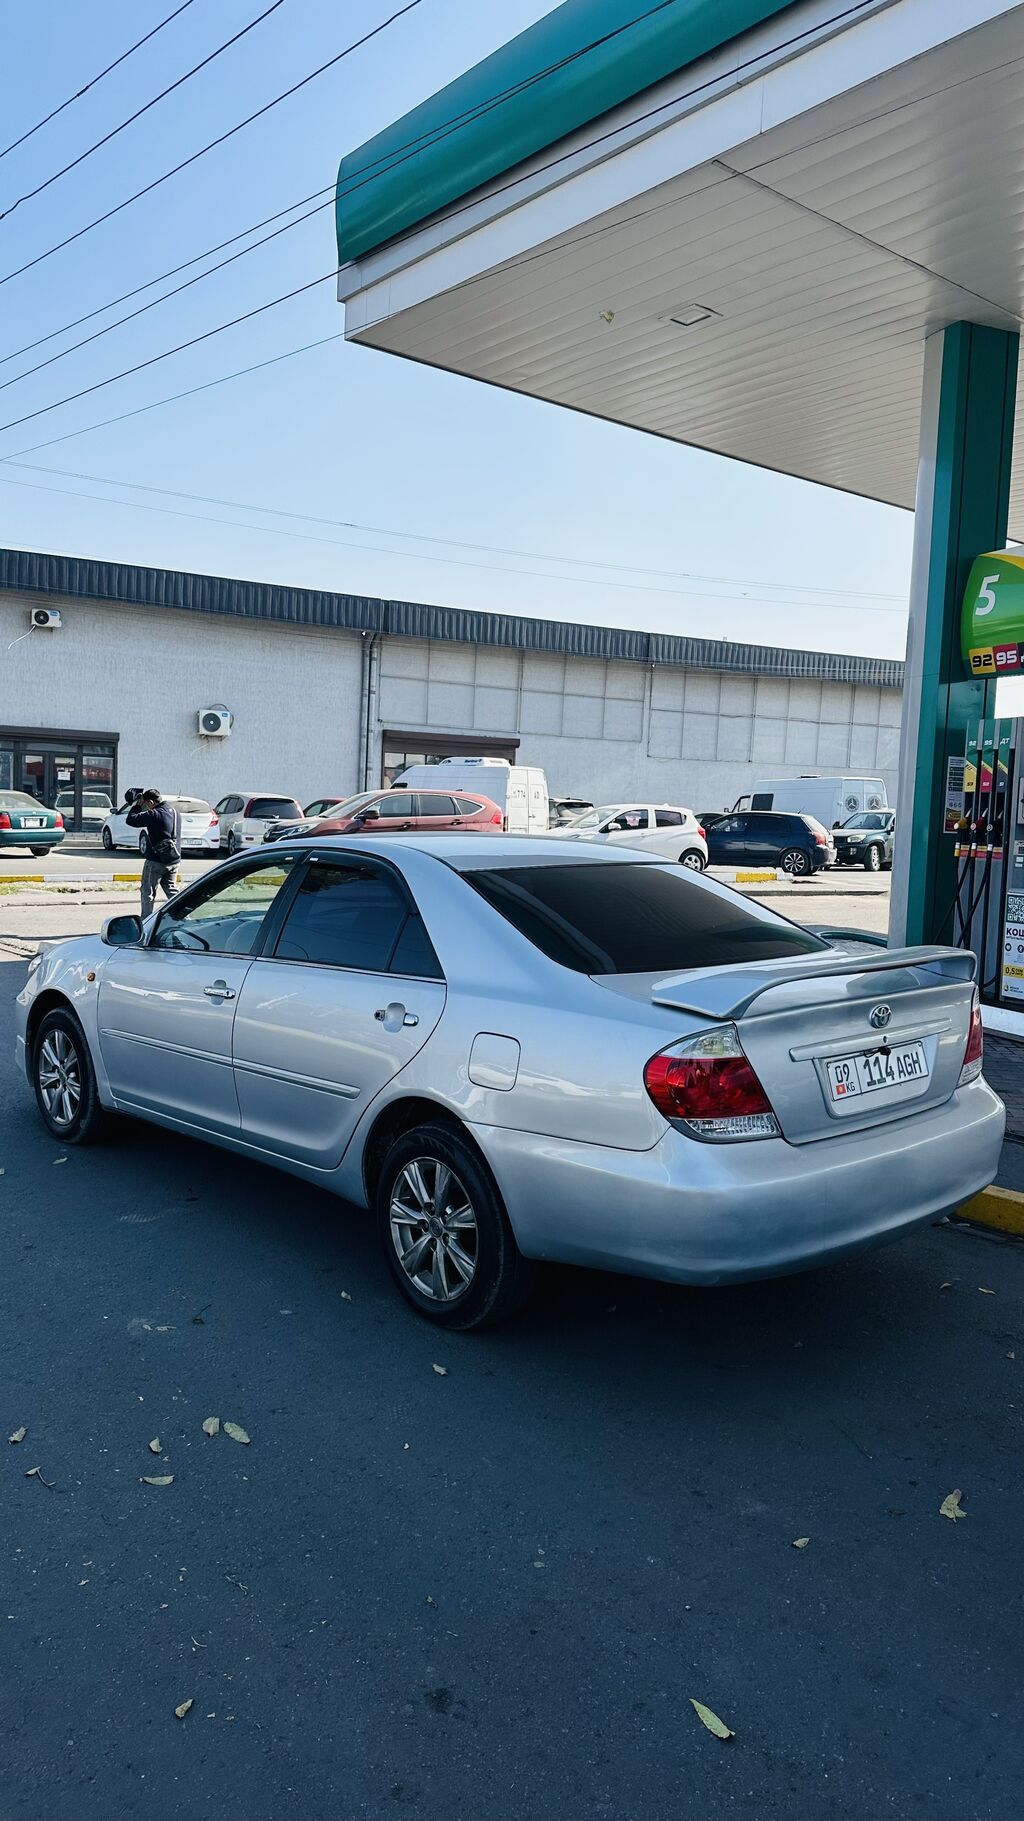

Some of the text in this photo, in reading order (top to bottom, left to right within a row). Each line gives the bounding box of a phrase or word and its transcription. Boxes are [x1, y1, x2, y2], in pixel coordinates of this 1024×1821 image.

[975, 574, 1000, 616] 5
[972, 654, 993, 668] 92
[996, 650, 1018, 665] 95
[1000, 737, 1010, 746] ДТ
[834, 1051, 922, 1087] 09 114 AGH
[845, 1081, 856, 1092] KG
